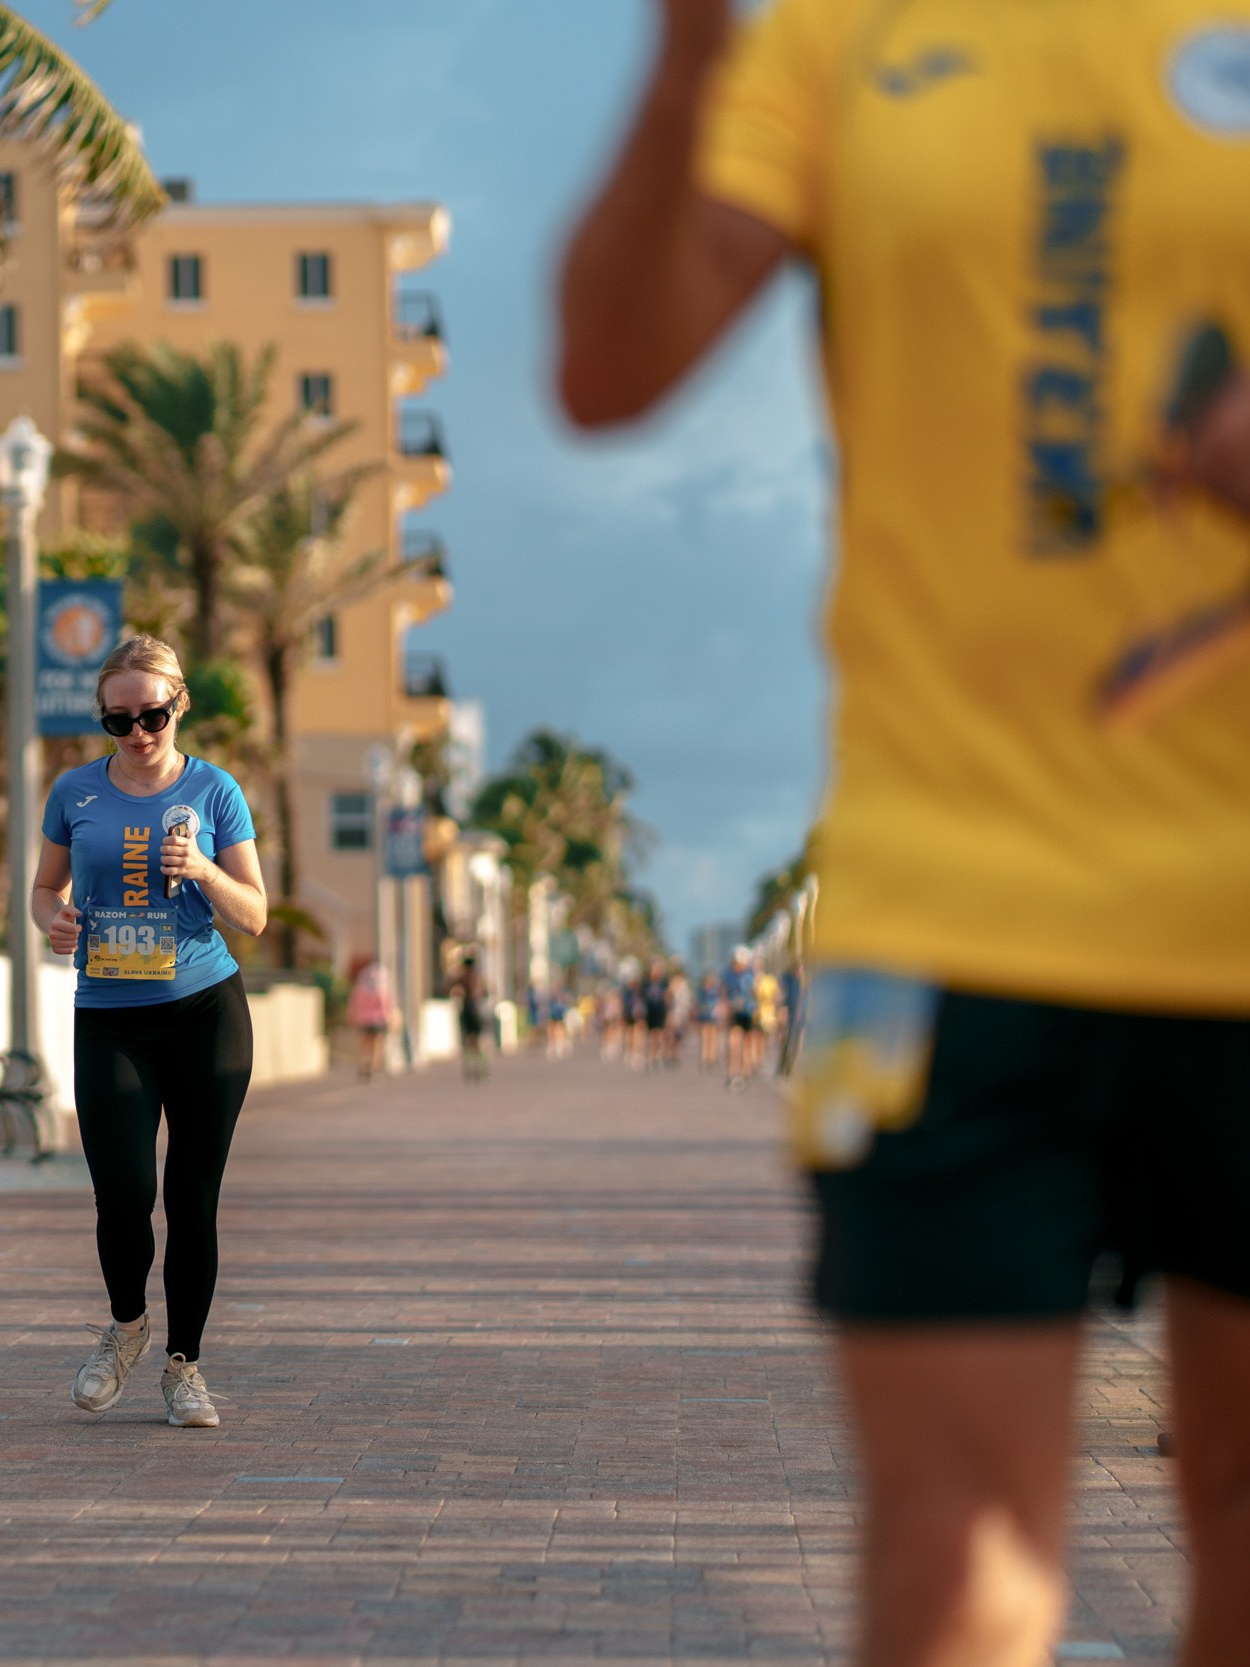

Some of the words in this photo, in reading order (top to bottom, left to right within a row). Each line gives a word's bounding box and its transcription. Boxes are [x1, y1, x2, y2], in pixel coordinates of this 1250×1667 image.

[122, 826, 150, 907] RAINE
[94, 911, 127, 919] RAZOM
[146, 912, 167, 920] RUN
[104, 925, 155, 956] 193
